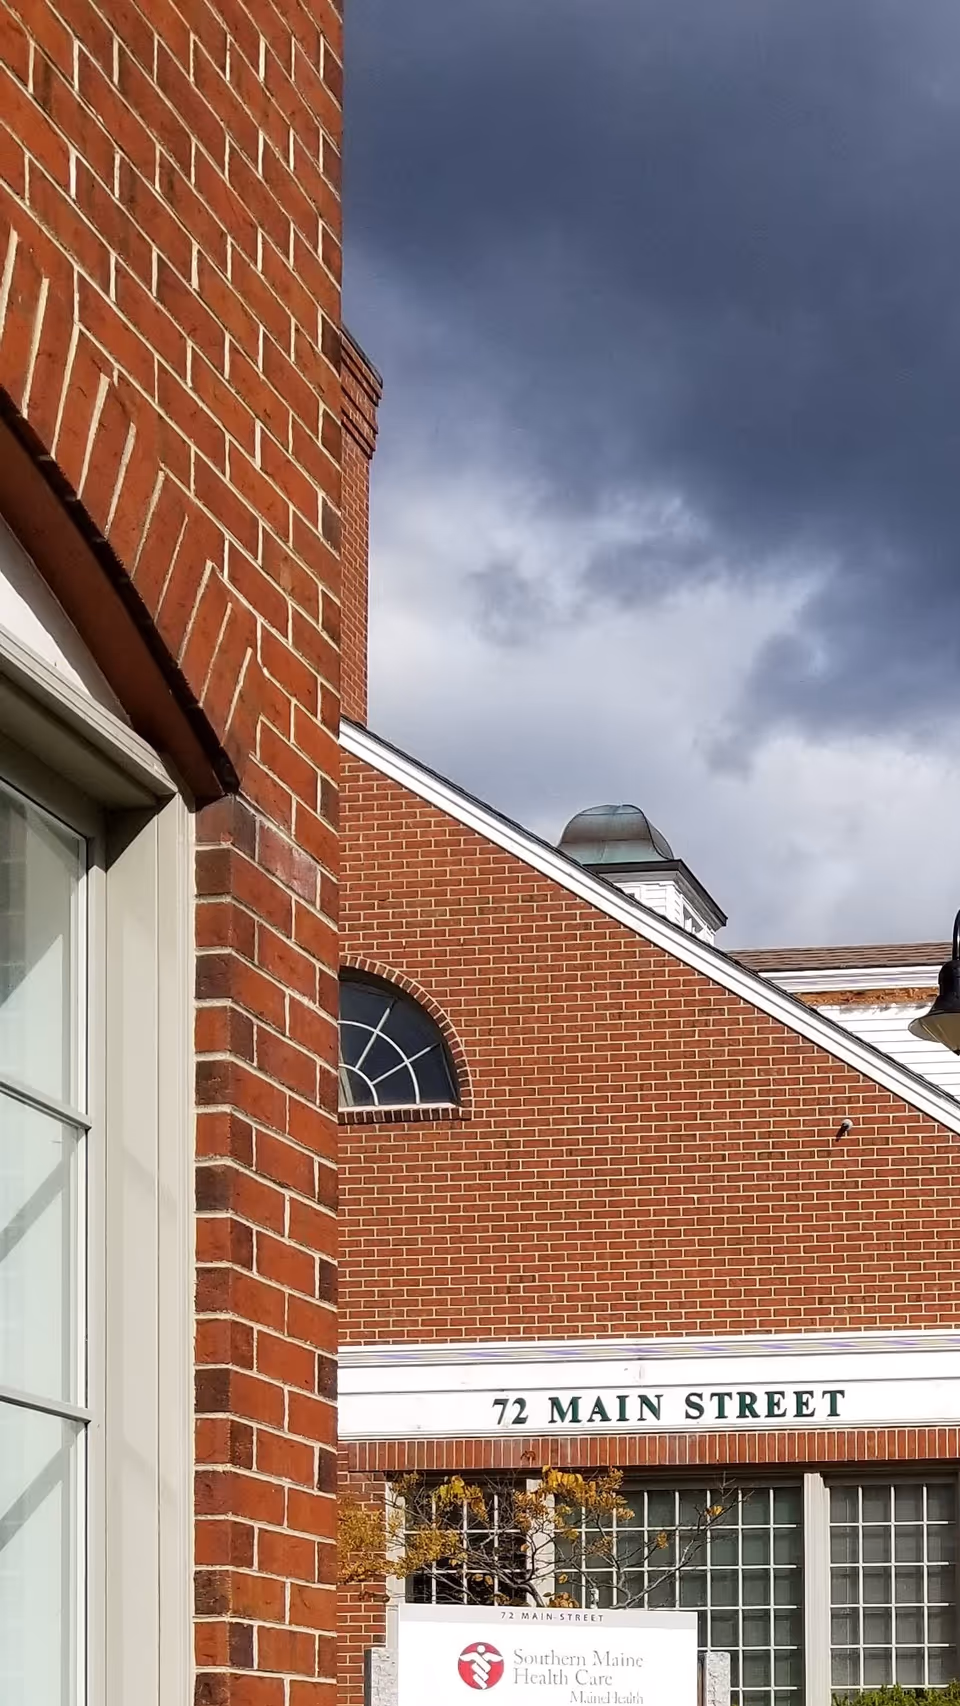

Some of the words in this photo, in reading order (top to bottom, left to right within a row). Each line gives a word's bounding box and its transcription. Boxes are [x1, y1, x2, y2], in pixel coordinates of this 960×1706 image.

[492, 1398, 529, 1425] 72
[548, 1394, 664, 1424] MAIN
[685, 1390, 845, 1419] STREET
[521, 1612, 553, 1620] MAIN
[560, 1613, 604, 1622] STREET
[513, 1649, 587, 1666] Southern
[592, 1650, 644, 1668] Maine
[513, 1667, 568, 1685] Health
[575, 1669, 613, 1686] Care
[569, 1690, 644, 1705] MaineHealth
